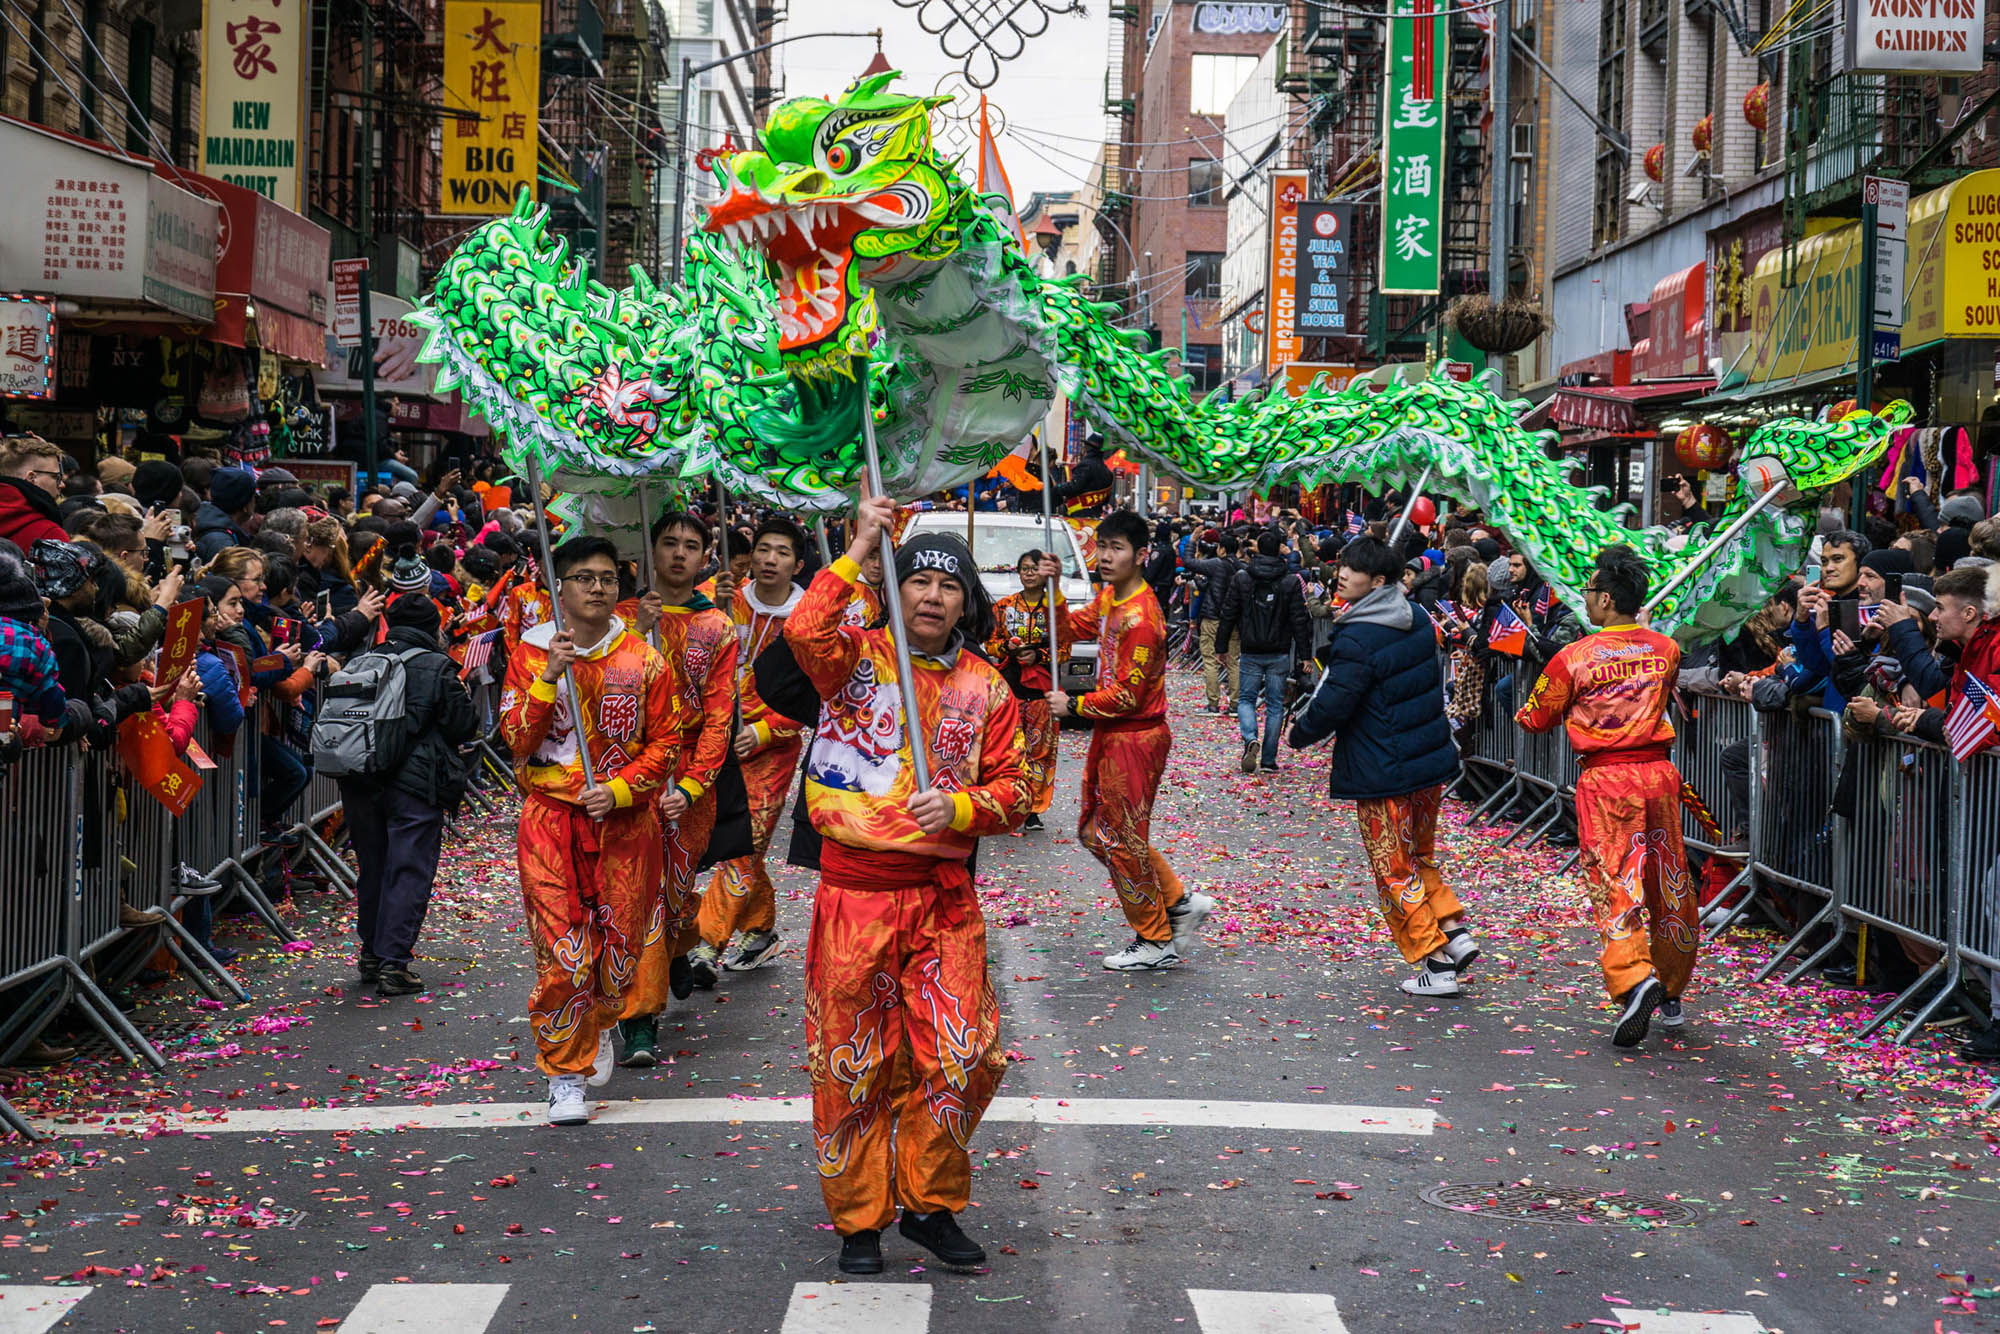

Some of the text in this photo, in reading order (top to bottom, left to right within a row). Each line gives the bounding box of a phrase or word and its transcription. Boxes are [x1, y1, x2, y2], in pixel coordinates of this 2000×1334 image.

[1869, 0, 1975, 19] WONTON
[226, 0, 281, 80] 家
[1875, 29, 1967, 51] GARDEN
[470, 8, 511, 103] 大旺
[232, 101, 270, 130] NEW
[456, 112, 526, 140] 飯店
[206, 136, 295, 168] MANDARIN
[466, 148, 514, 173] BIG
[222, 174, 278, 201] URT
[449, 178, 532, 206] WONG
[1279, 216, 1298, 278] CANTON
[1307, 240, 1344, 254] JULIA
[1312, 255, 1337, 269] TEA
[1318, 270, 1330, 283] &
[1310, 283, 1337, 297] DIM
[1308, 299, 1339, 313] SUM
[1276, 288, 1296, 350] LOUNGE
[1301, 313, 1344, 327] HOUSE
[0, 325, 42, 363] 道
[0, 373, 16, 383] 78
[14, 364, 35, 373] DAO
[913, 550, 959, 573] NYC
[1600, 643, 1654, 660] New York
[1588, 656, 1669, 684] UNITED
